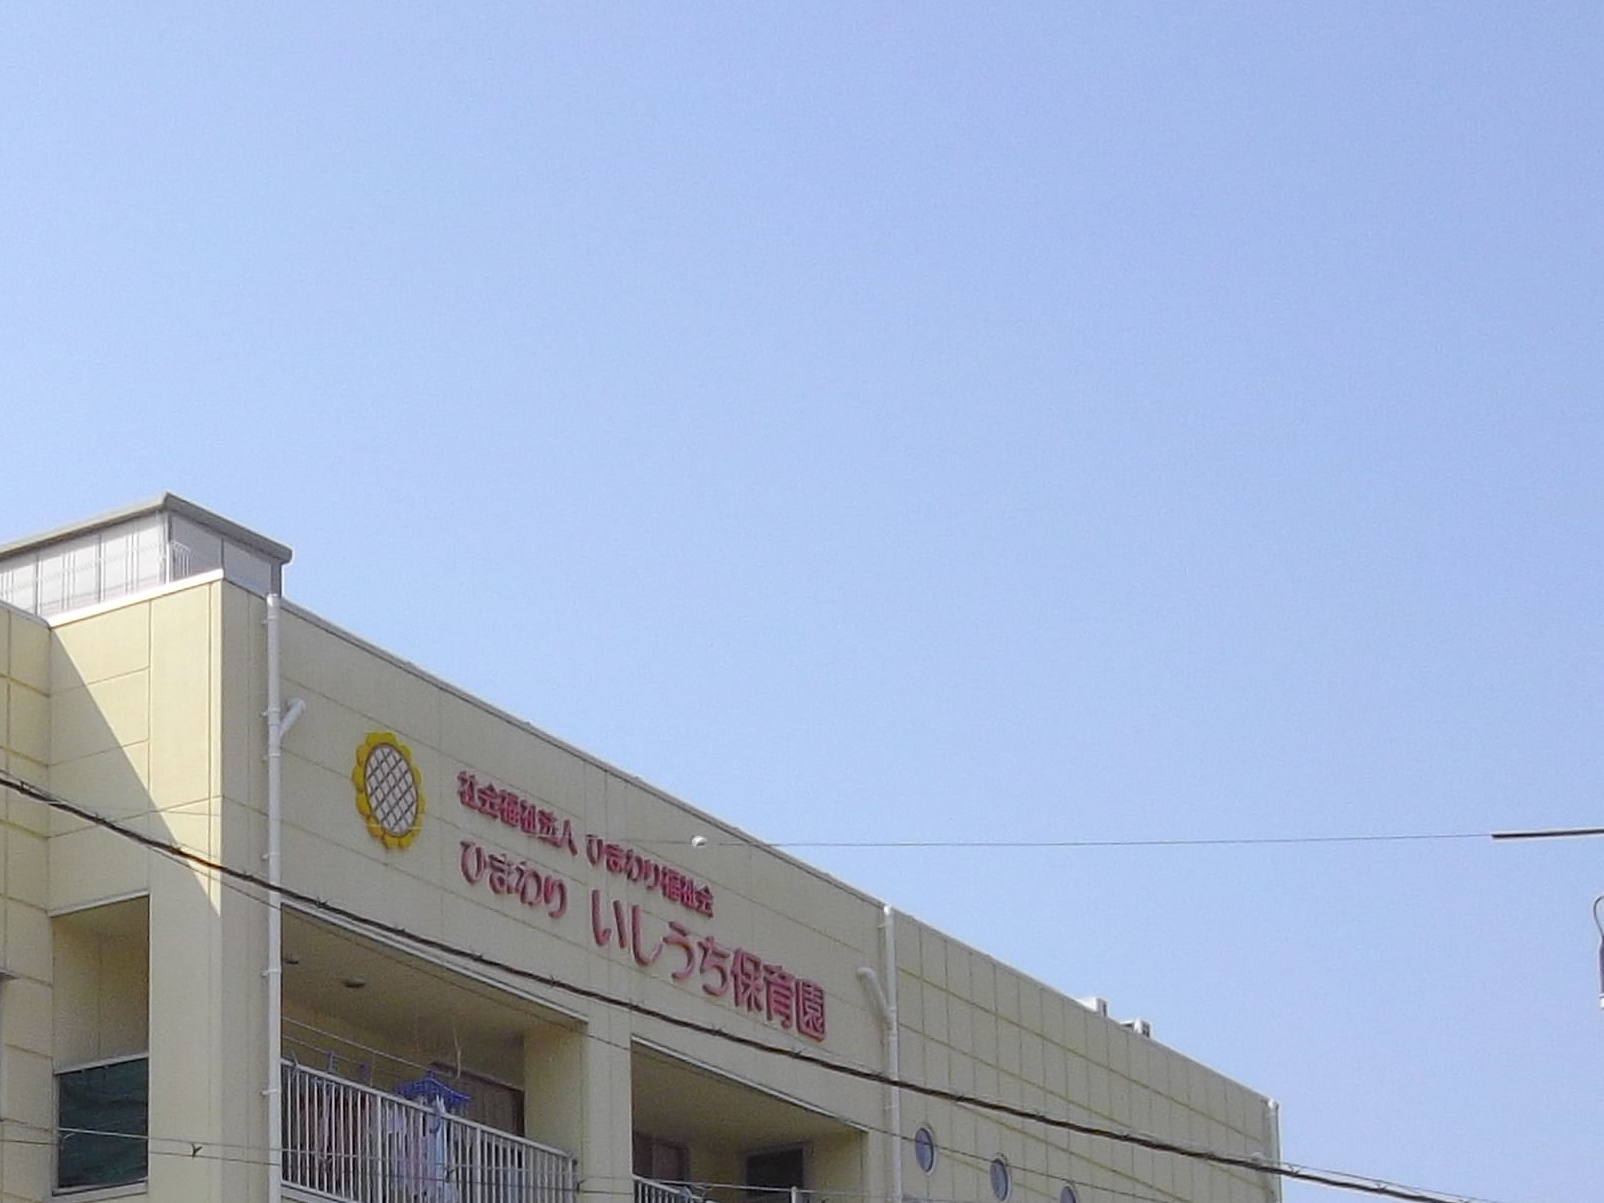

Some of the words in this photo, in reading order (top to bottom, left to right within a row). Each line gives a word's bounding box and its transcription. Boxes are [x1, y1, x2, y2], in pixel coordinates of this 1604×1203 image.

[457, 771, 578, 856] 社会福祉法人
[585, 834, 714, 918] ひまわり福祉会
[460, 840, 567, 919] ひまわり
[591, 889, 826, 1042] いしうち保育園
